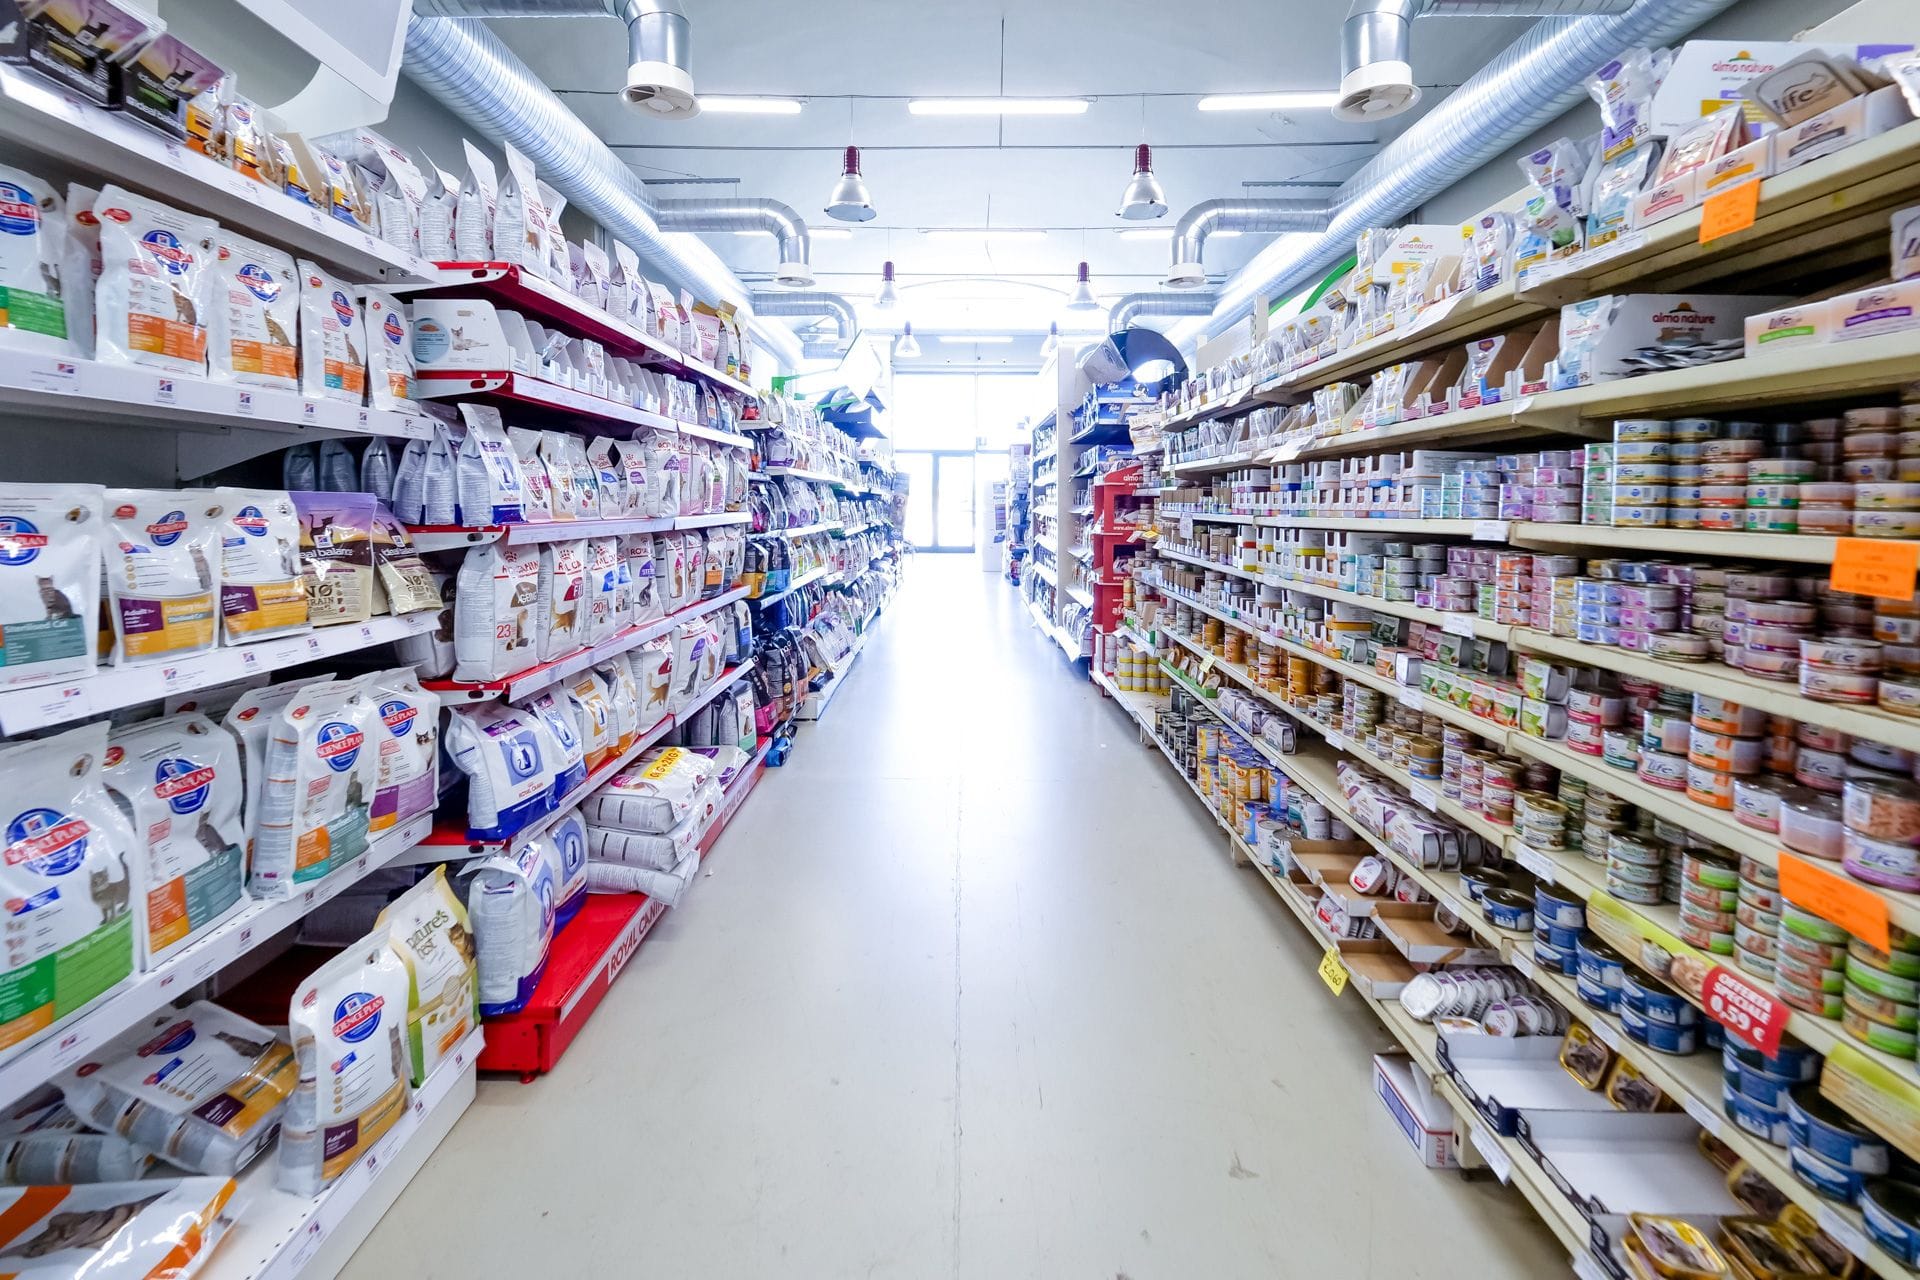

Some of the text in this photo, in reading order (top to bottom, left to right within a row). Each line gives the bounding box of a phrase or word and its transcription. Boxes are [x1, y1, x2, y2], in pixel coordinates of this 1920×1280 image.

[1712, 61, 1776, 73] almo nature
[1652, 312, 1715, 325] almo nature
[497, 623, 511, 639] 23
[406, 909, 450, 949] nature's
[610, 898, 665, 976] ROYAL CANIN
[1709, 994, 1767, 1043] 0,59 €
[1712, 981, 1772, 1026] SPECIALE
[1435, 1136, 1446, 1165] JELLY
